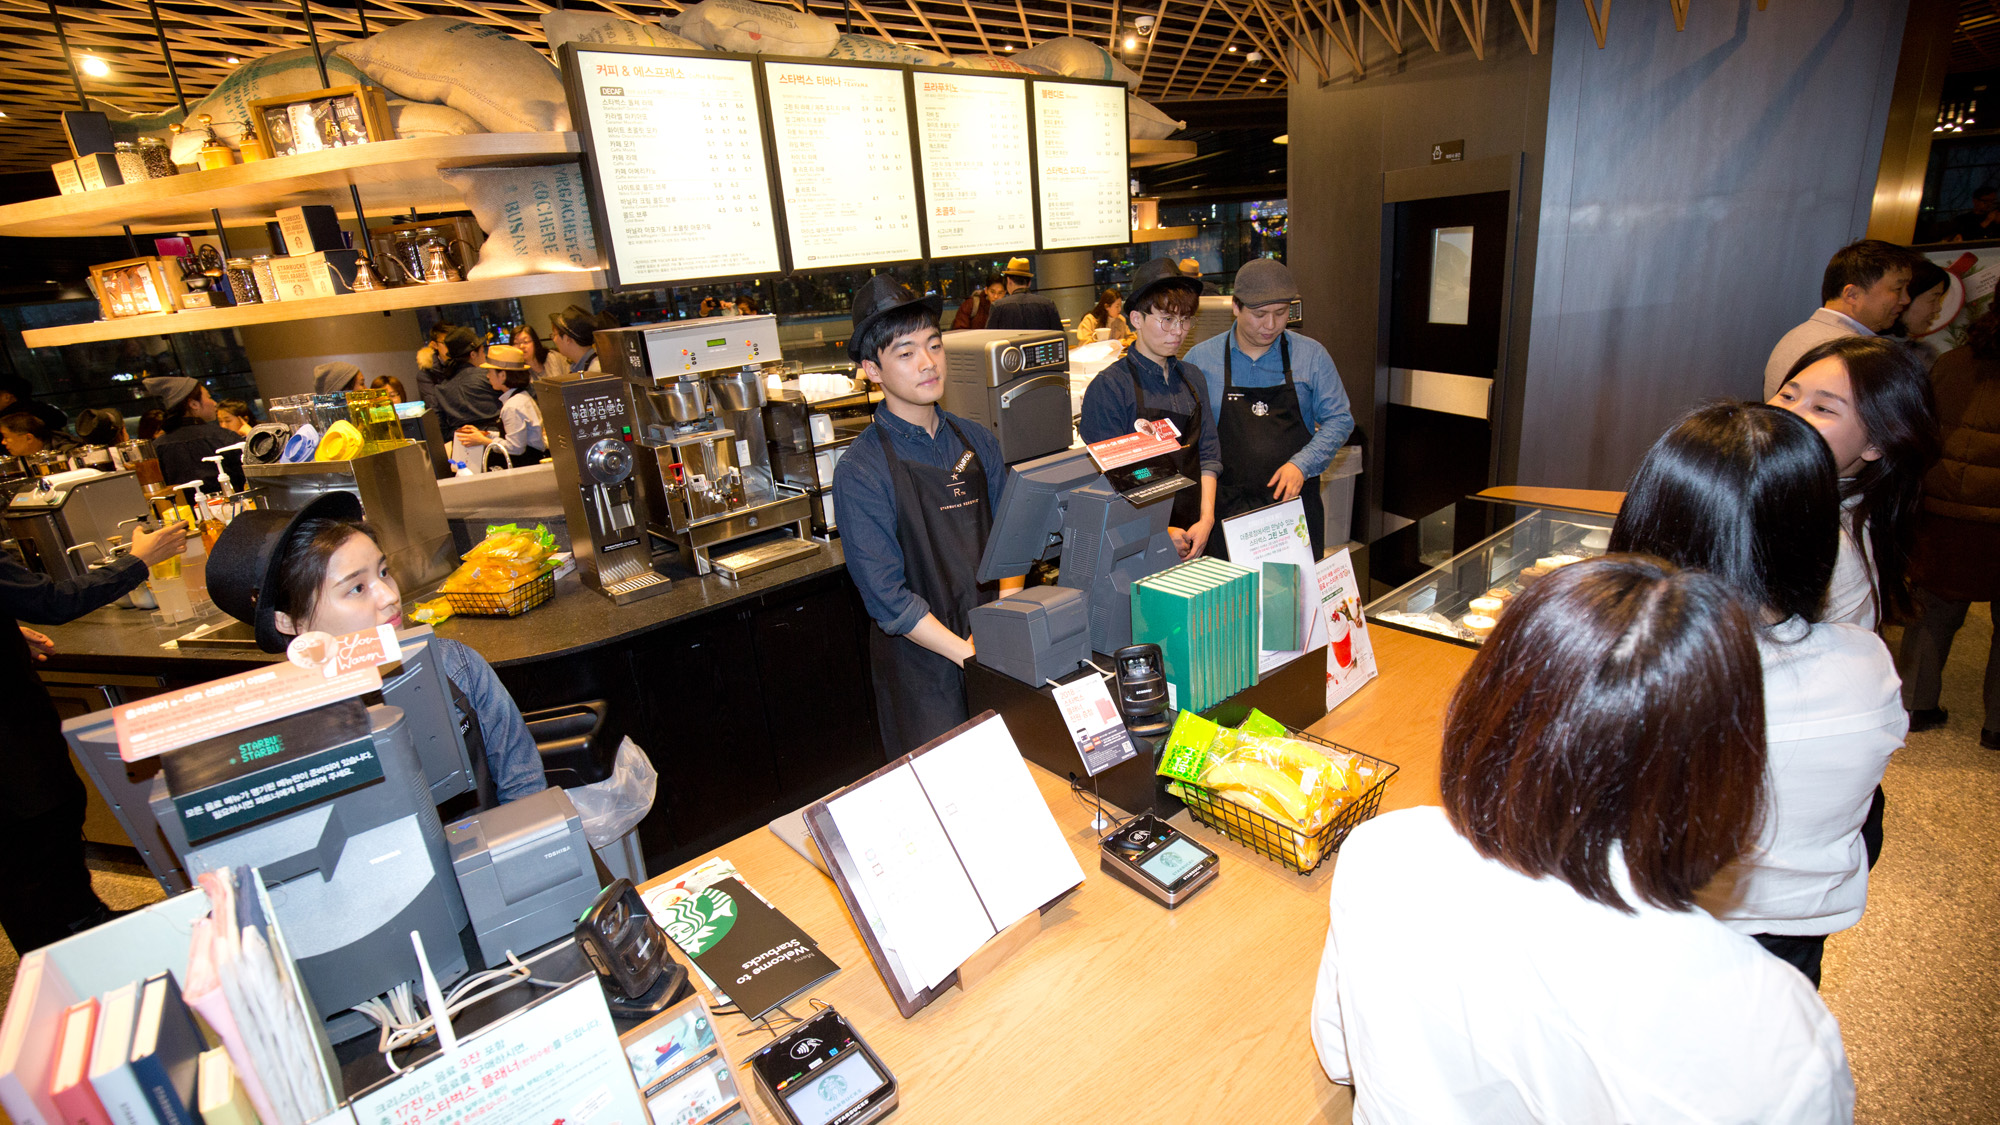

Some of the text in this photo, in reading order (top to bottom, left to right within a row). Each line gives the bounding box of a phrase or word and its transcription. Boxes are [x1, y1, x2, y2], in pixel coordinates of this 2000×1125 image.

[596, 64, 686, 80] 커피 & 에스프레소
[779, 74, 814, 85] 스타벅스
[816, 76, 842, 87] 티바나
[924, 82, 960, 92] 프라푸치노
[1042, 89, 1064, 99] 블렌디드
[1046, 166, 1069, 175] 스타벅스
[532, 180, 560, 254] KOCHERE
[936, 206, 956, 216] 초콜릿
[504, 200, 528, 256] BUSAN
[1268, 531, 1277, 540] 그린
[1279, 528, 1288, 537] 노트
[337, 632, 381, 660] You
[337, 650, 387, 670] Warm
[185, 808, 204, 818] 모든
[224, 791, 250, 807] 메뉴가
[250, 782, 275, 799] 명기된
[276, 774, 308, 794] 메뉴판이
[308, 761, 341, 779] 준비되어
[341, 751, 374, 770] 있습니다.
[212, 768, 354, 820] 필요하시면 파트너에게 문의하여 주세요.
[544, 846, 572, 860] TOSHIBA
[1183, 864, 1204, 880] STARBUCKS
[736, 945, 810, 984] Welcome to
[741, 939, 800, 970] Starbucks
[374, 1039, 506, 1116] 크리스마스 음료 3잔 포함
[424, 1084, 478, 1120] 스타벅스
[563, 1019, 601, 1044] 드립니다.
[394, 1090, 436, 1119] 17잔의
[437, 1072, 471, 1095] 음료를
[825, 1088, 862, 1116] STARBUCKS
[834, 1099, 869, 1125] STARBUCKS
